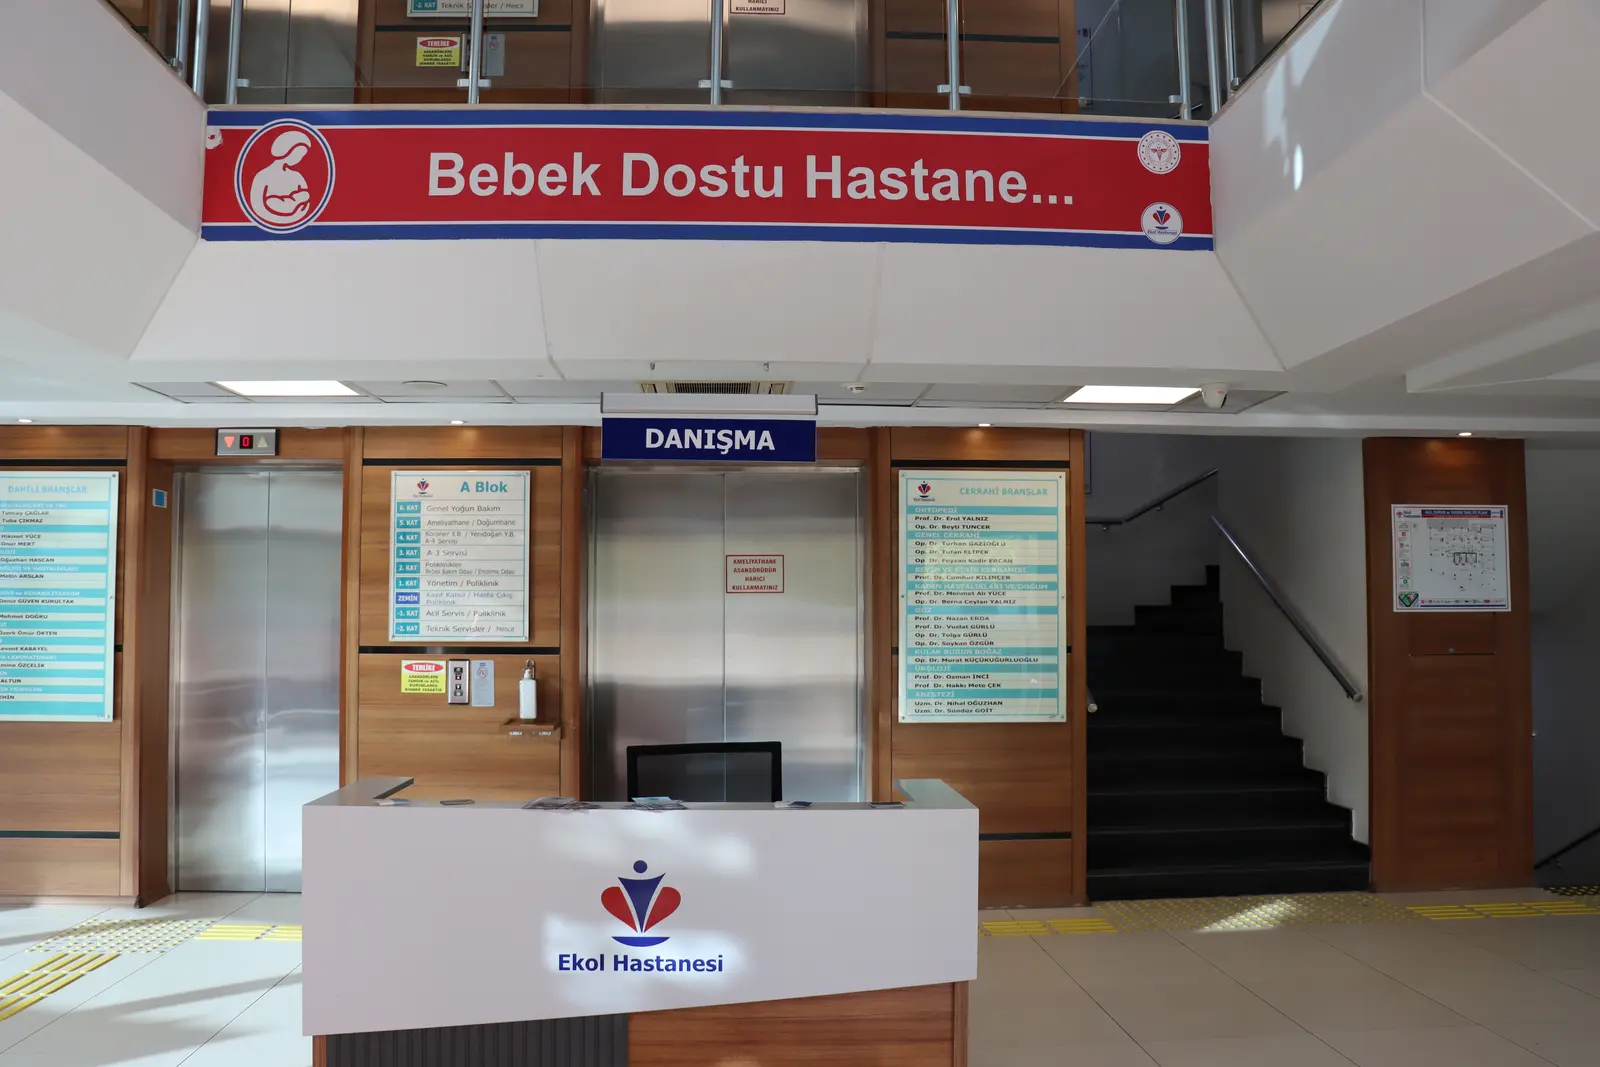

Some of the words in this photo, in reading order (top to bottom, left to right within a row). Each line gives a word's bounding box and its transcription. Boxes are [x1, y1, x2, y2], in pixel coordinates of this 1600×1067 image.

[428, 152, 601, 196] Bebek
[622, 153, 783, 198] Dostu
[806, 155, 1073, 205] Hastane...
[242, 436, 250, 447] 0
[646, 428, 775, 454] DANIŞMA
[461, 482, 470, 492] A
[476, 482, 508, 492] Blok
[452, 505, 474, 513] Yoğun
[559, 954, 604, 971] Ekol
[614, 955, 723, 972] Hastanesi
